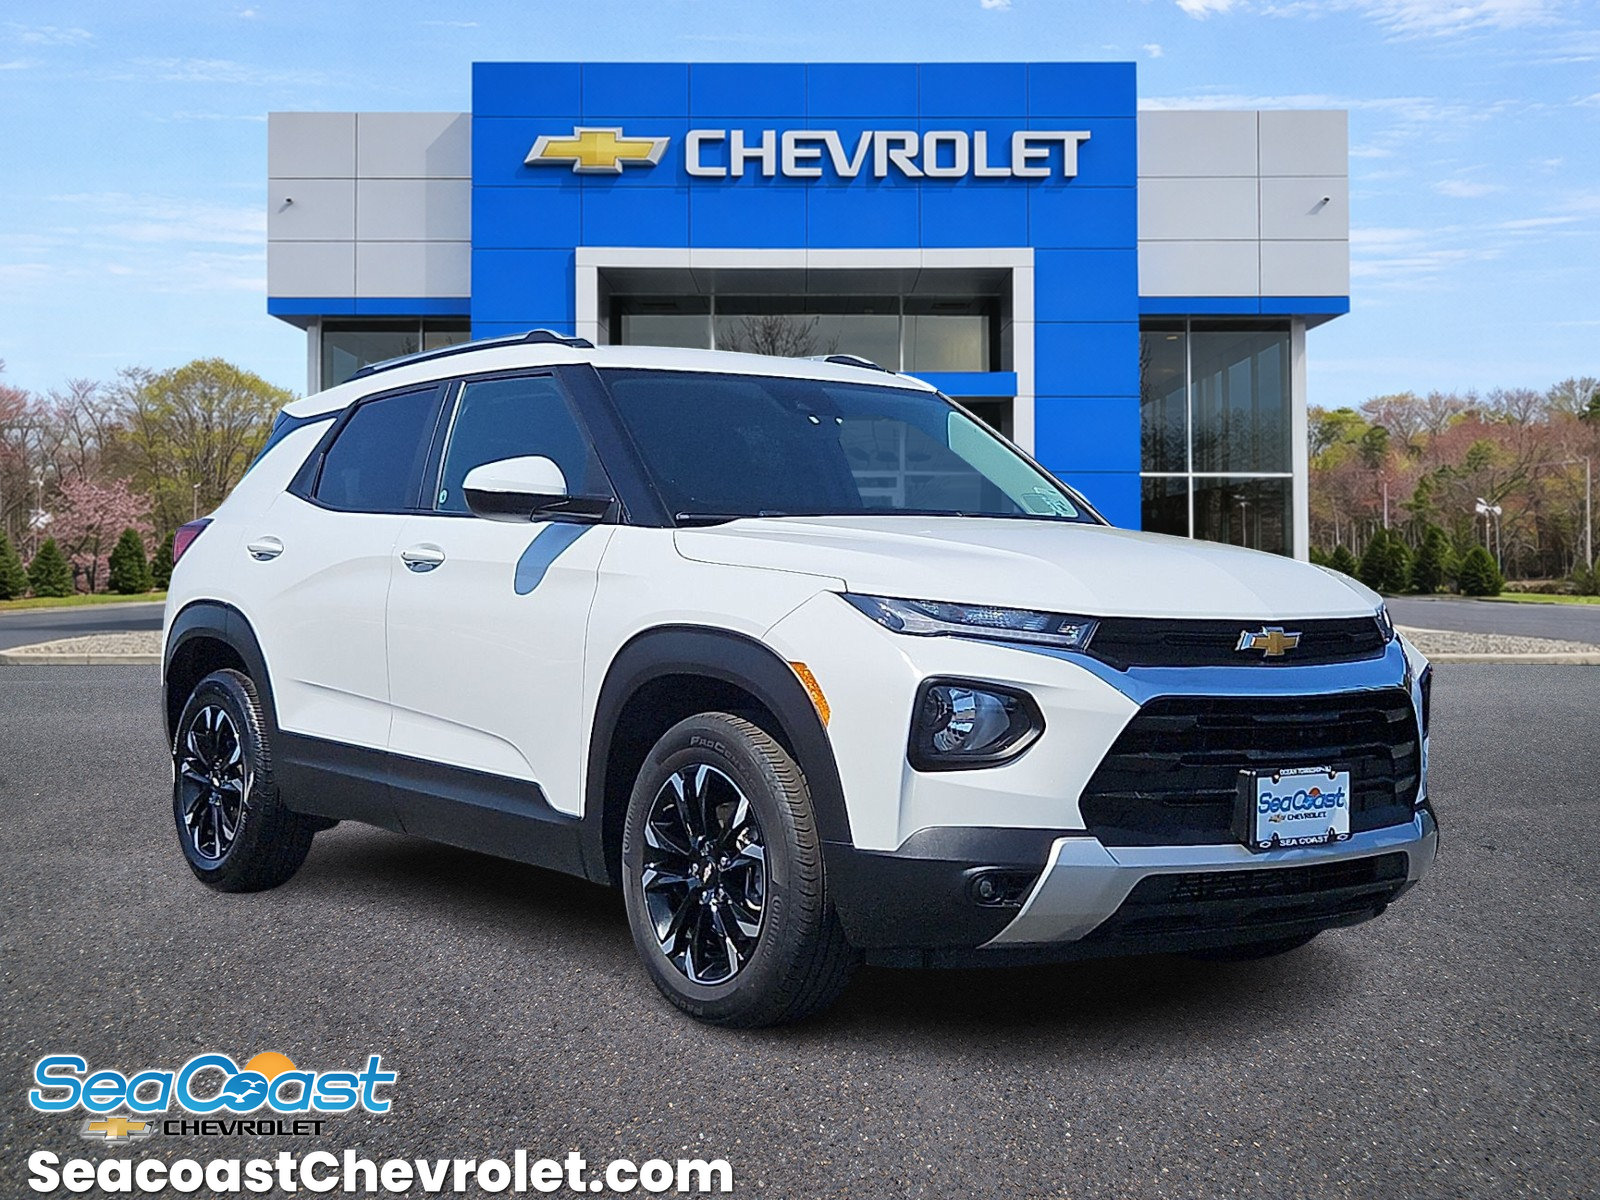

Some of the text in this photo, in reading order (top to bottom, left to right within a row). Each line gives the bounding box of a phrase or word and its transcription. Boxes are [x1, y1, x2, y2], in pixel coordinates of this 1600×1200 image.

[685, 129, 1091, 177] CHEVROLET
[1287, 811, 1327, 821] CHEVROLET
[1279, 835, 1328, 847] SEA COAST
